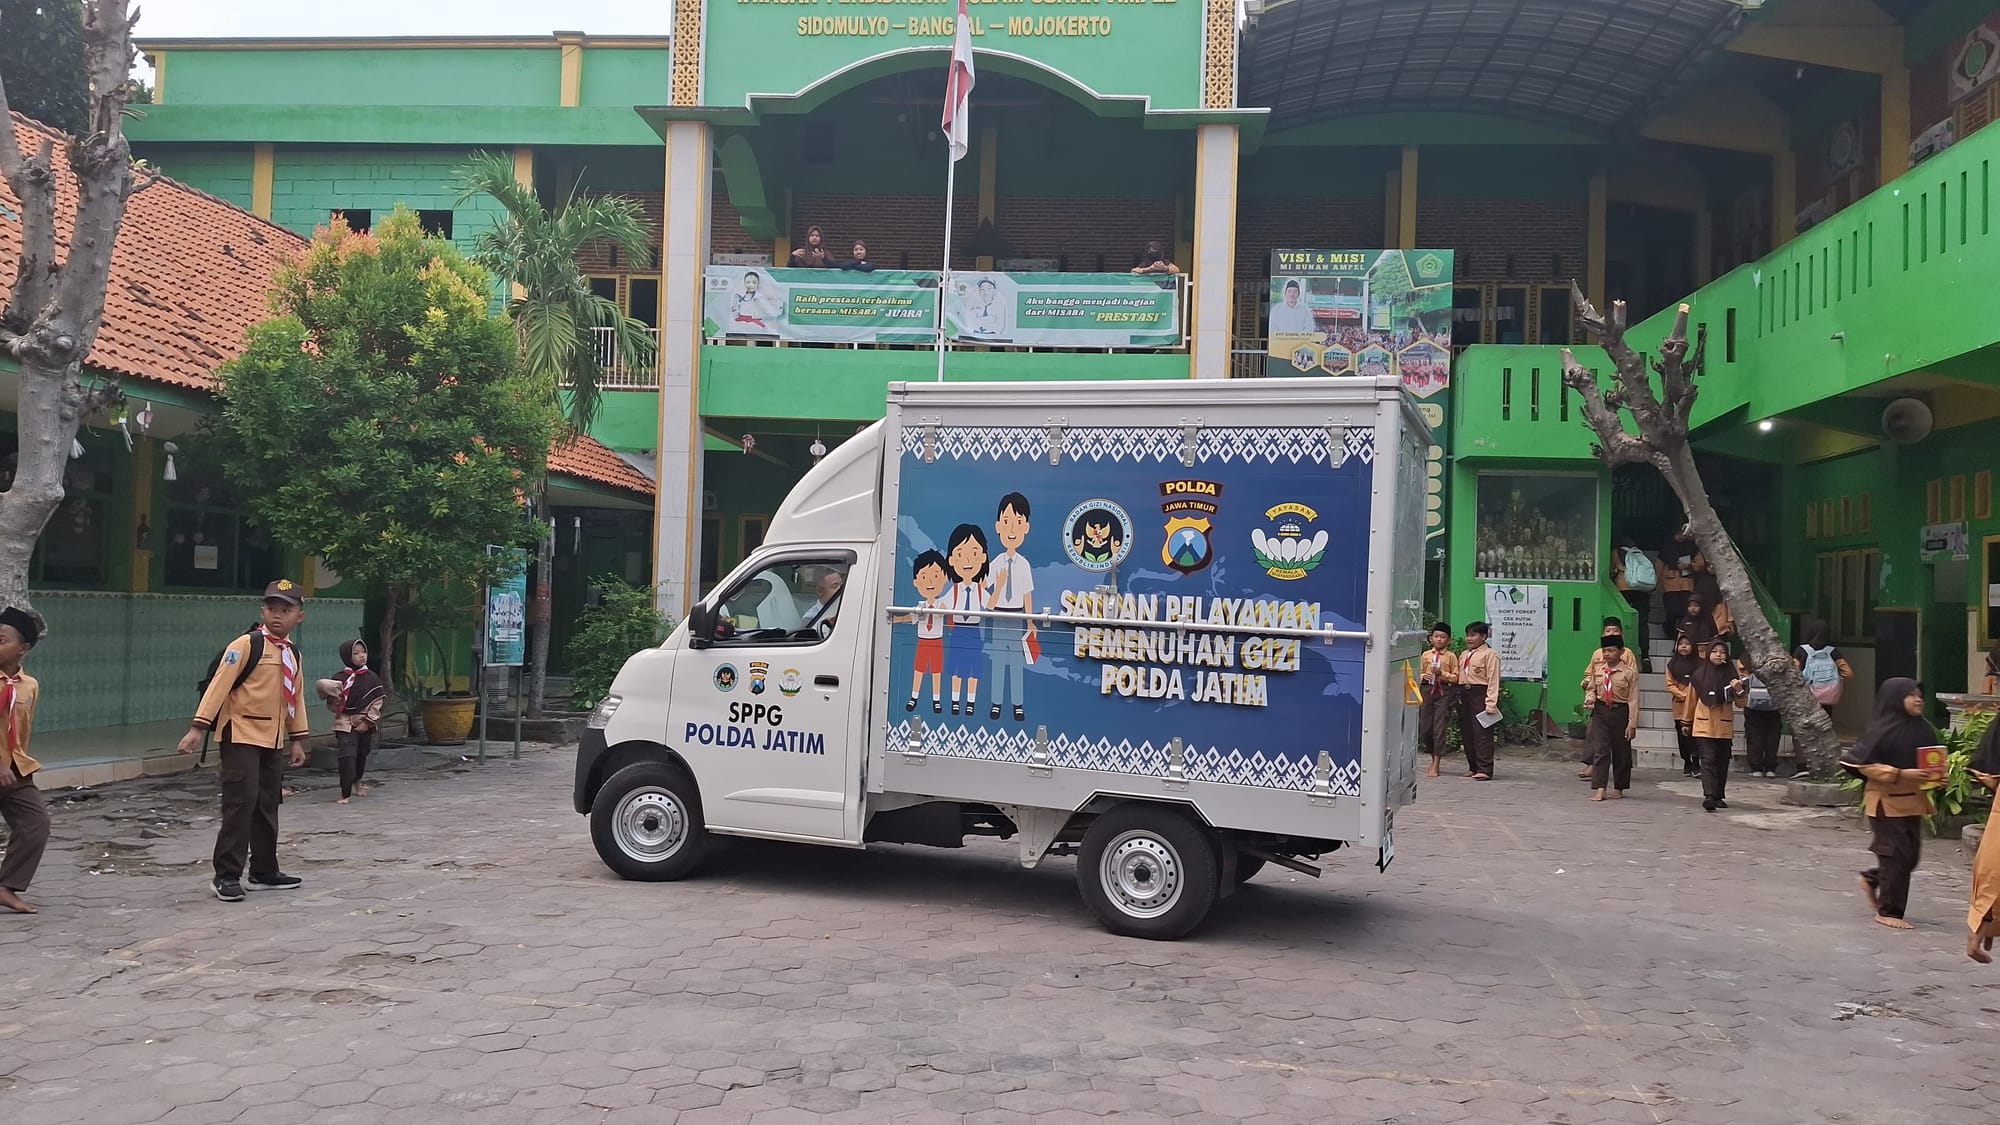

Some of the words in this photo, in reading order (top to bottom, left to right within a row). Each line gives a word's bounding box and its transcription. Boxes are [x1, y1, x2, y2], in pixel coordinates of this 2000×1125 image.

[797, 16, 888, 36] SIDOMULYO
[908, 16, 985, 36] BANGAL
[1008, 16, 1112, 36] MOJOKERTO
[1279, 253, 1311, 263] VISI
[1316, 254, 1325, 263] &
[1330, 253, 1365, 263] MISI
[795, 295, 817, 303] Raih
[819, 296, 860, 305] prestasi
[861, 297, 913, 305] terbaikmu
[1045, 298, 1080, 306] bangga
[1082, 298, 1120, 306] menjadi
[795, 306, 836, 315] bersama
[839, 308, 877, 316] MISABA
[1025, 308, 1045, 316] dari
[1165, 481, 1216, 495] POLDA
[1069, 505, 1088, 523] BADAN
[1103, 502, 1129, 526] NASIONAL
[1164, 502, 1187, 512] JAWA
[1189, 501, 1216, 513] TIMUR
[1272, 505, 1312, 516] YAYASAN
[1067, 544, 1095, 569] REPUBLIK
[1165, 595, 1321, 630] PELAYANAN
[1073, 627, 1235, 668] PEMENUHAN
[1240, 635, 1301, 672] GIZI
[1101, 664, 1185, 701] POLDA
[1191, 670, 1268, 707] JATIM
[728, 701, 783, 726] SPPG
[685, 722, 756, 749] POLDA
[762, 729, 825, 755] JATIM
